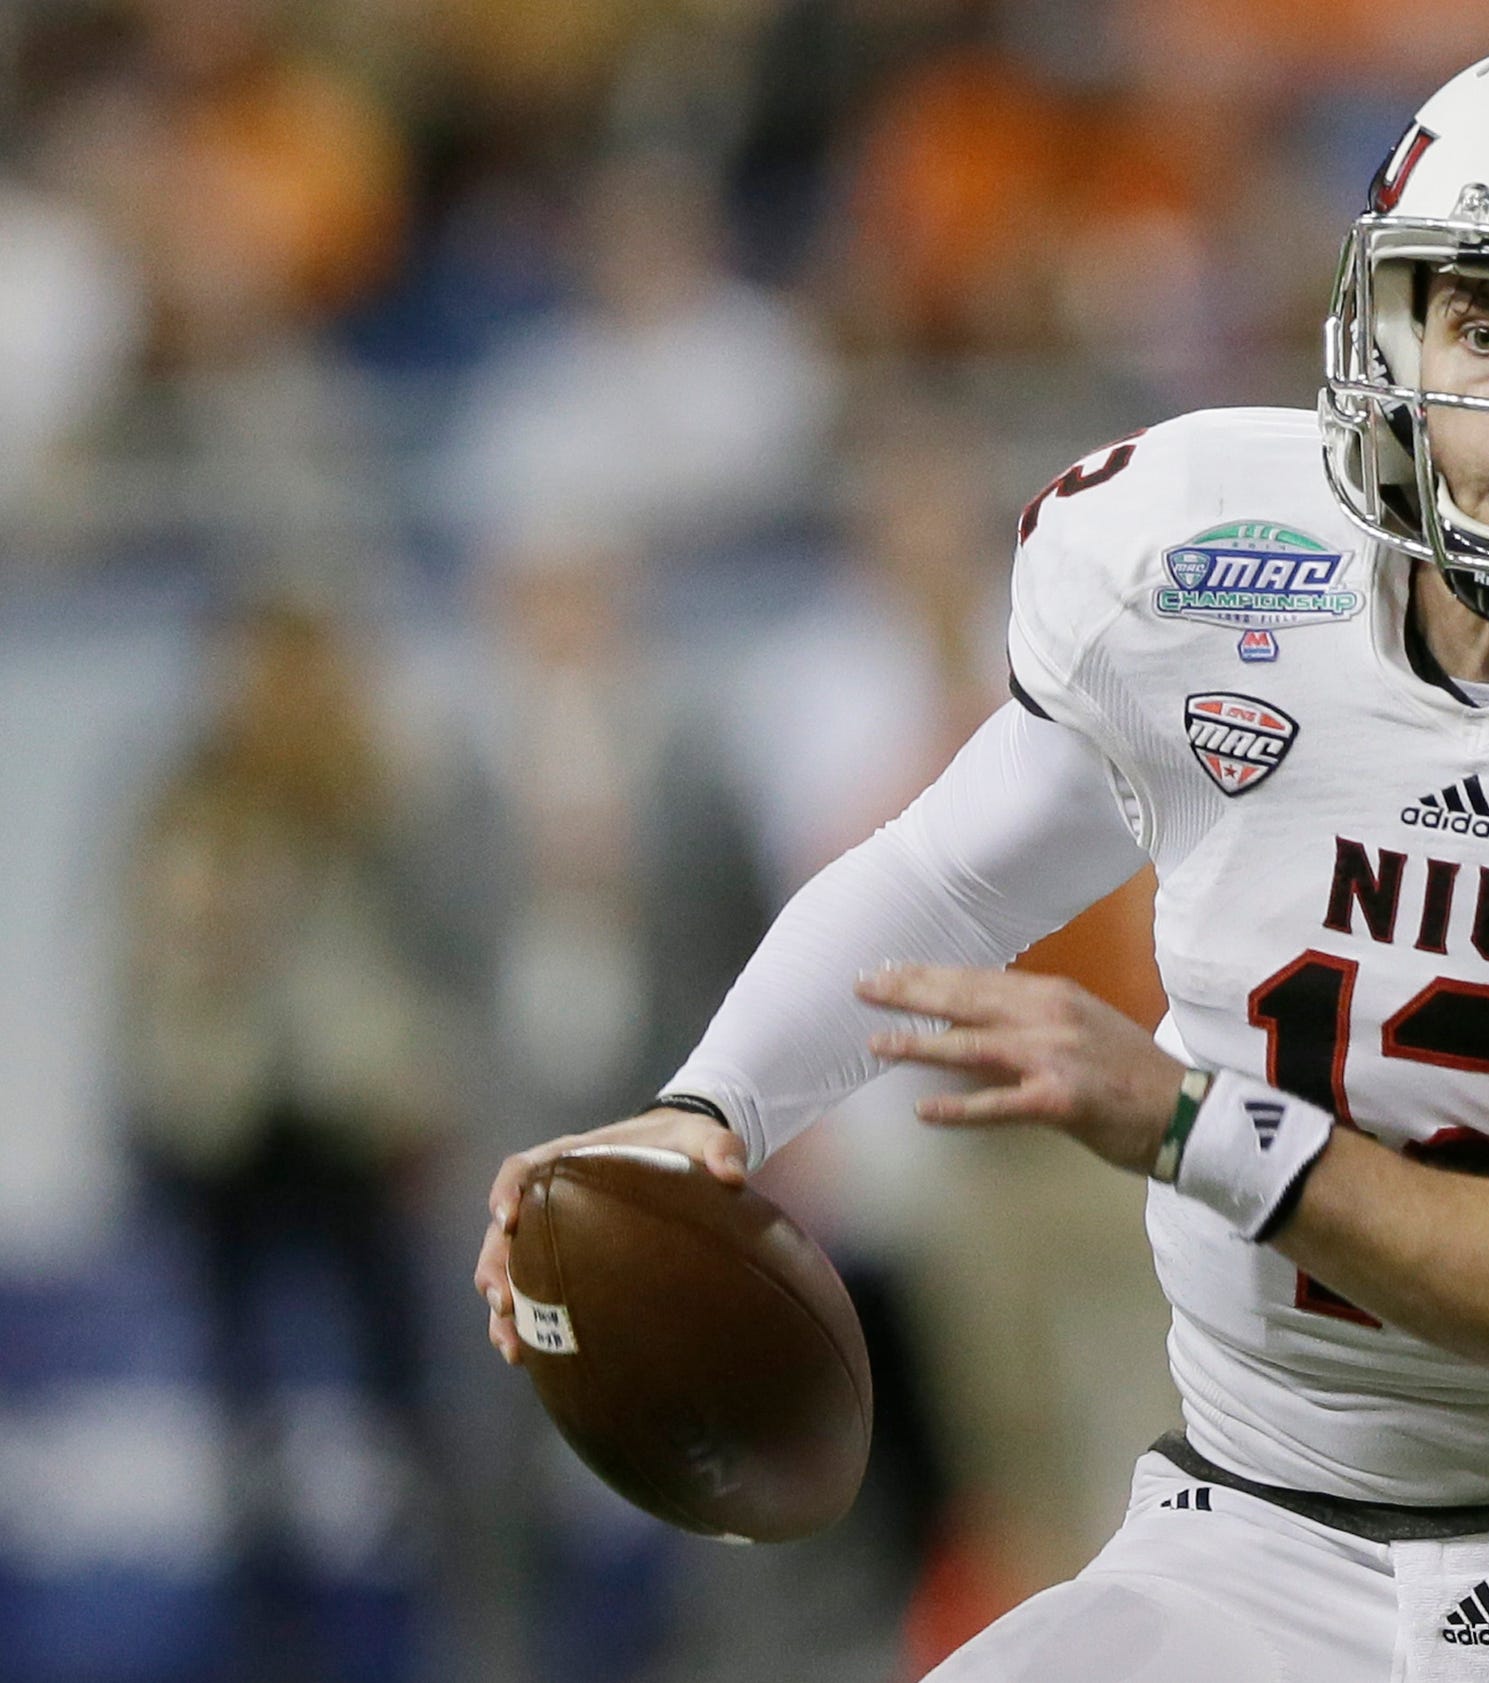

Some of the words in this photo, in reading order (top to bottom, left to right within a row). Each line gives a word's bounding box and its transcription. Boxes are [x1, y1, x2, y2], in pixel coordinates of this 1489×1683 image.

[1206, 555, 1335, 591] MAC
[1159, 589, 1356, 615] CHAMPIONSHIP
[1188, 719, 1286, 764] MAC
